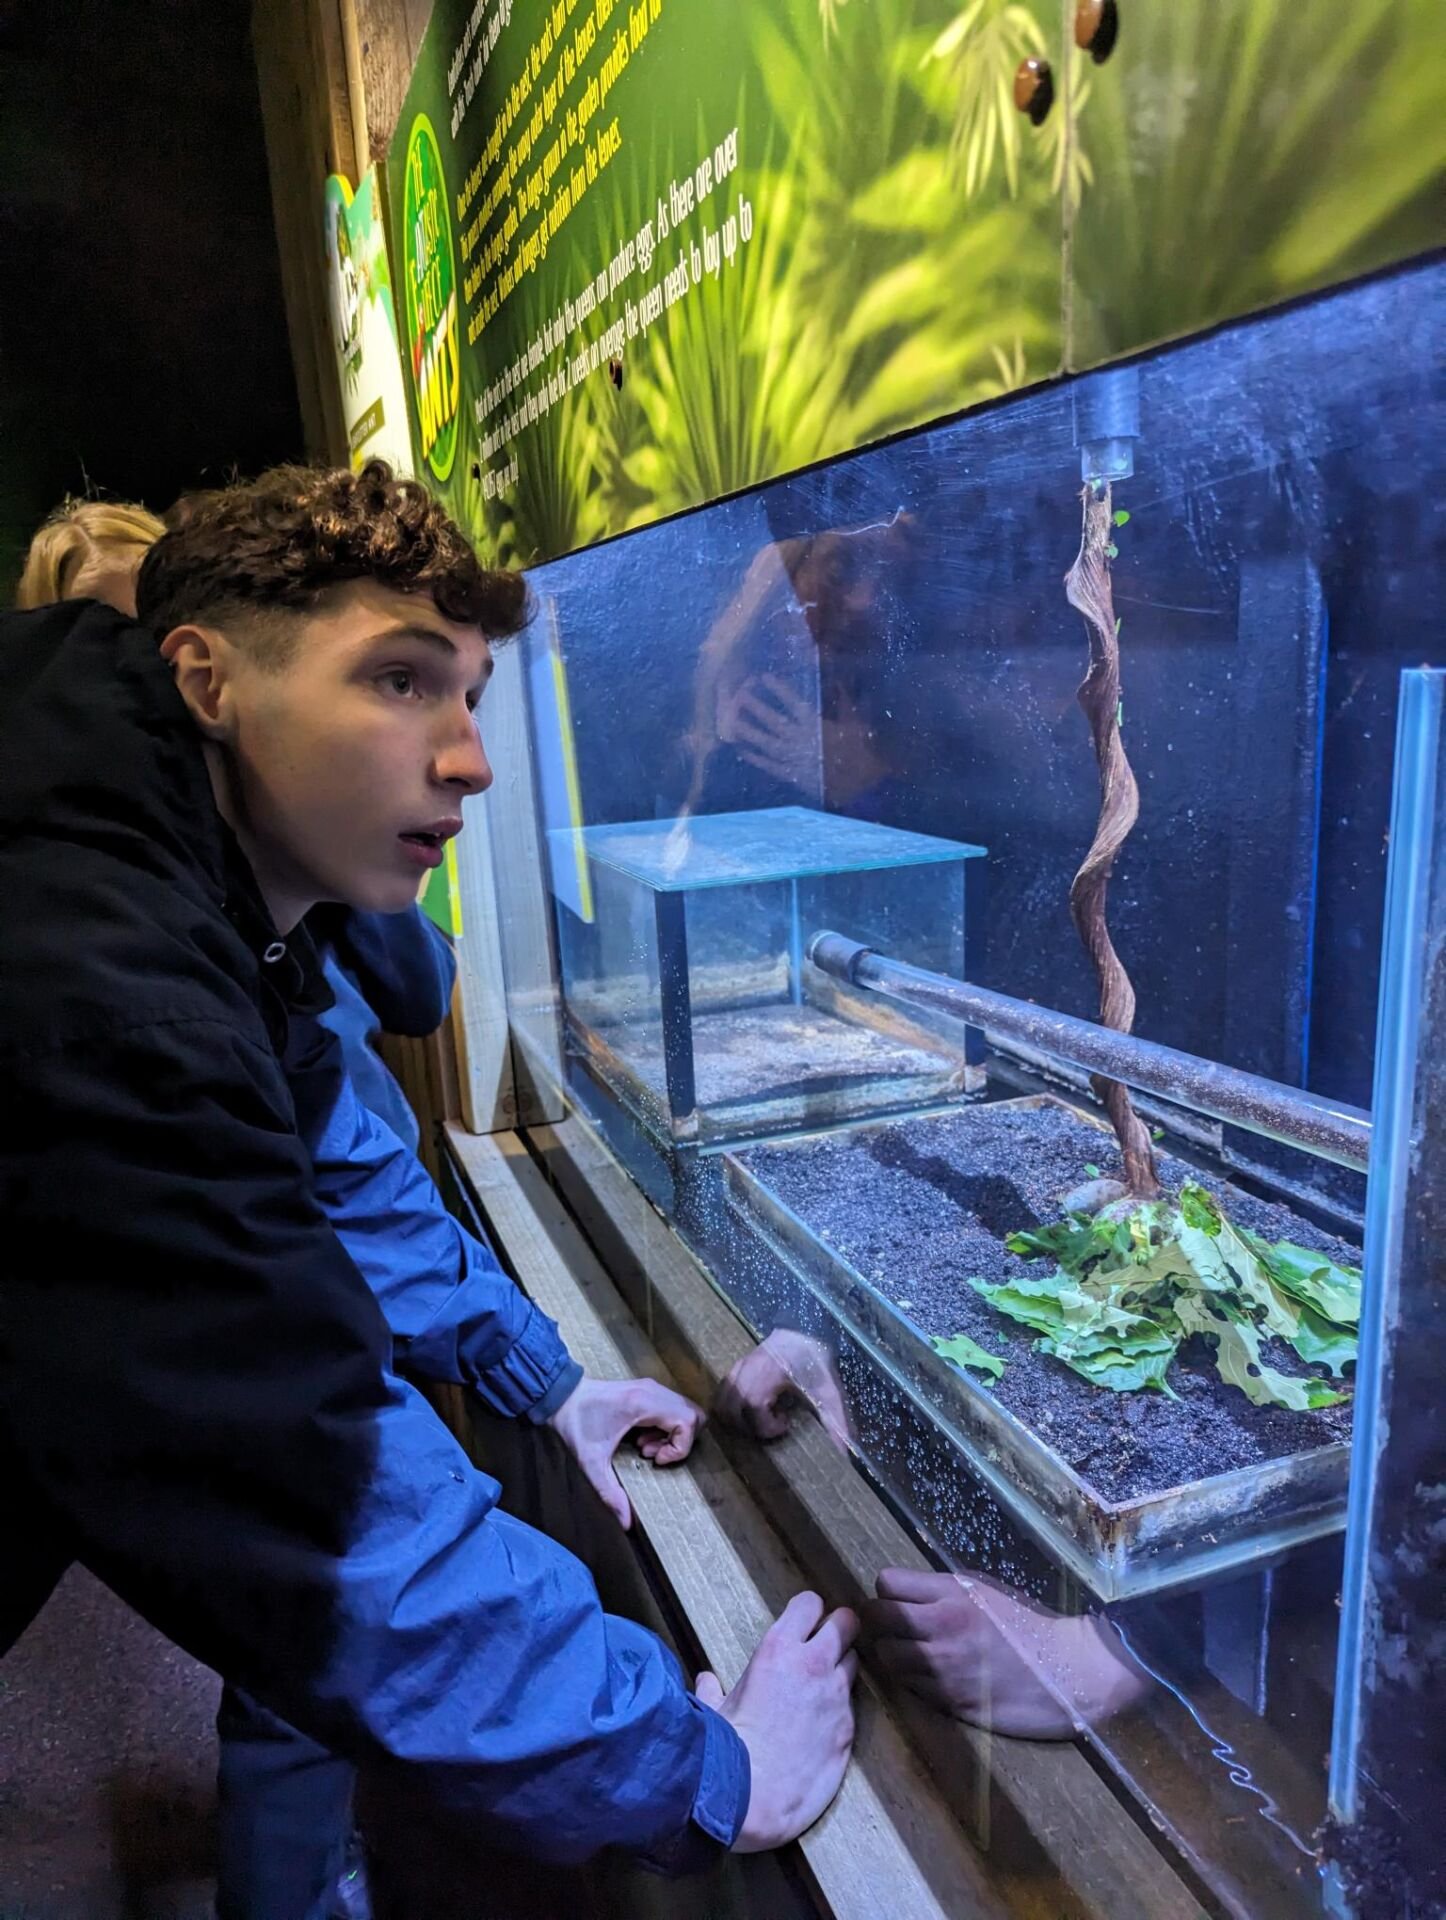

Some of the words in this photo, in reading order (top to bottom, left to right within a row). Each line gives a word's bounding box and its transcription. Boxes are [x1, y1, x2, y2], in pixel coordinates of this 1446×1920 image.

[509, 146, 518, 179] the
[543, 79, 557, 124] layer
[558, 55, 564, 98] of
[564, 45, 575, 84] the
[575, 11, 595, 66] leaves
[511, 84, 520, 117] the
[531, 46, 541, 80] the
[541, 20, 553, 64] ants
[517, 187, 527, 221] The
[527, 166, 543, 210] fungus
[560, 123, 567, 159] in
[566, 108, 578, 146] the
[578, 76, 599, 144] garden
[600, 29, 629, 109] provides
[630, 0, 648, 53] food
[540, 209, 549, 259] get
[571, 165, 586, 206] from
[585, 145, 597, 184] the
[597, 118, 621, 168] leaves.
[543, 319, 554, 356] but
[554, 308, 565, 349] only
[564, 299, 576, 334] the
[576, 282, 596, 333] queens
[597, 269, 608, 304] can
[609, 240, 635, 302] produce
[636, 220, 655, 274] eggs.
[658, 198, 669, 243] As
[670, 177, 694, 227] there
[696, 157, 712, 203] are
[715, 128, 738, 184] over
[420, 290, 460, 460] ANTS
[538, 379, 549, 417] only
[558, 364, 566, 398] for
[565, 356, 572, 390] 2
[571, 340, 590, 386] weeks
[591, 341, 599, 371] on
[600, 318, 625, 363] average
[625, 299, 638, 340] the
[640, 283, 663, 338] queen
[664, 249, 689, 310] needs
[690, 240, 701, 284] to
[703, 226, 720, 280] lay
[723, 215, 737, 267] up
[739, 193, 752, 242] to
